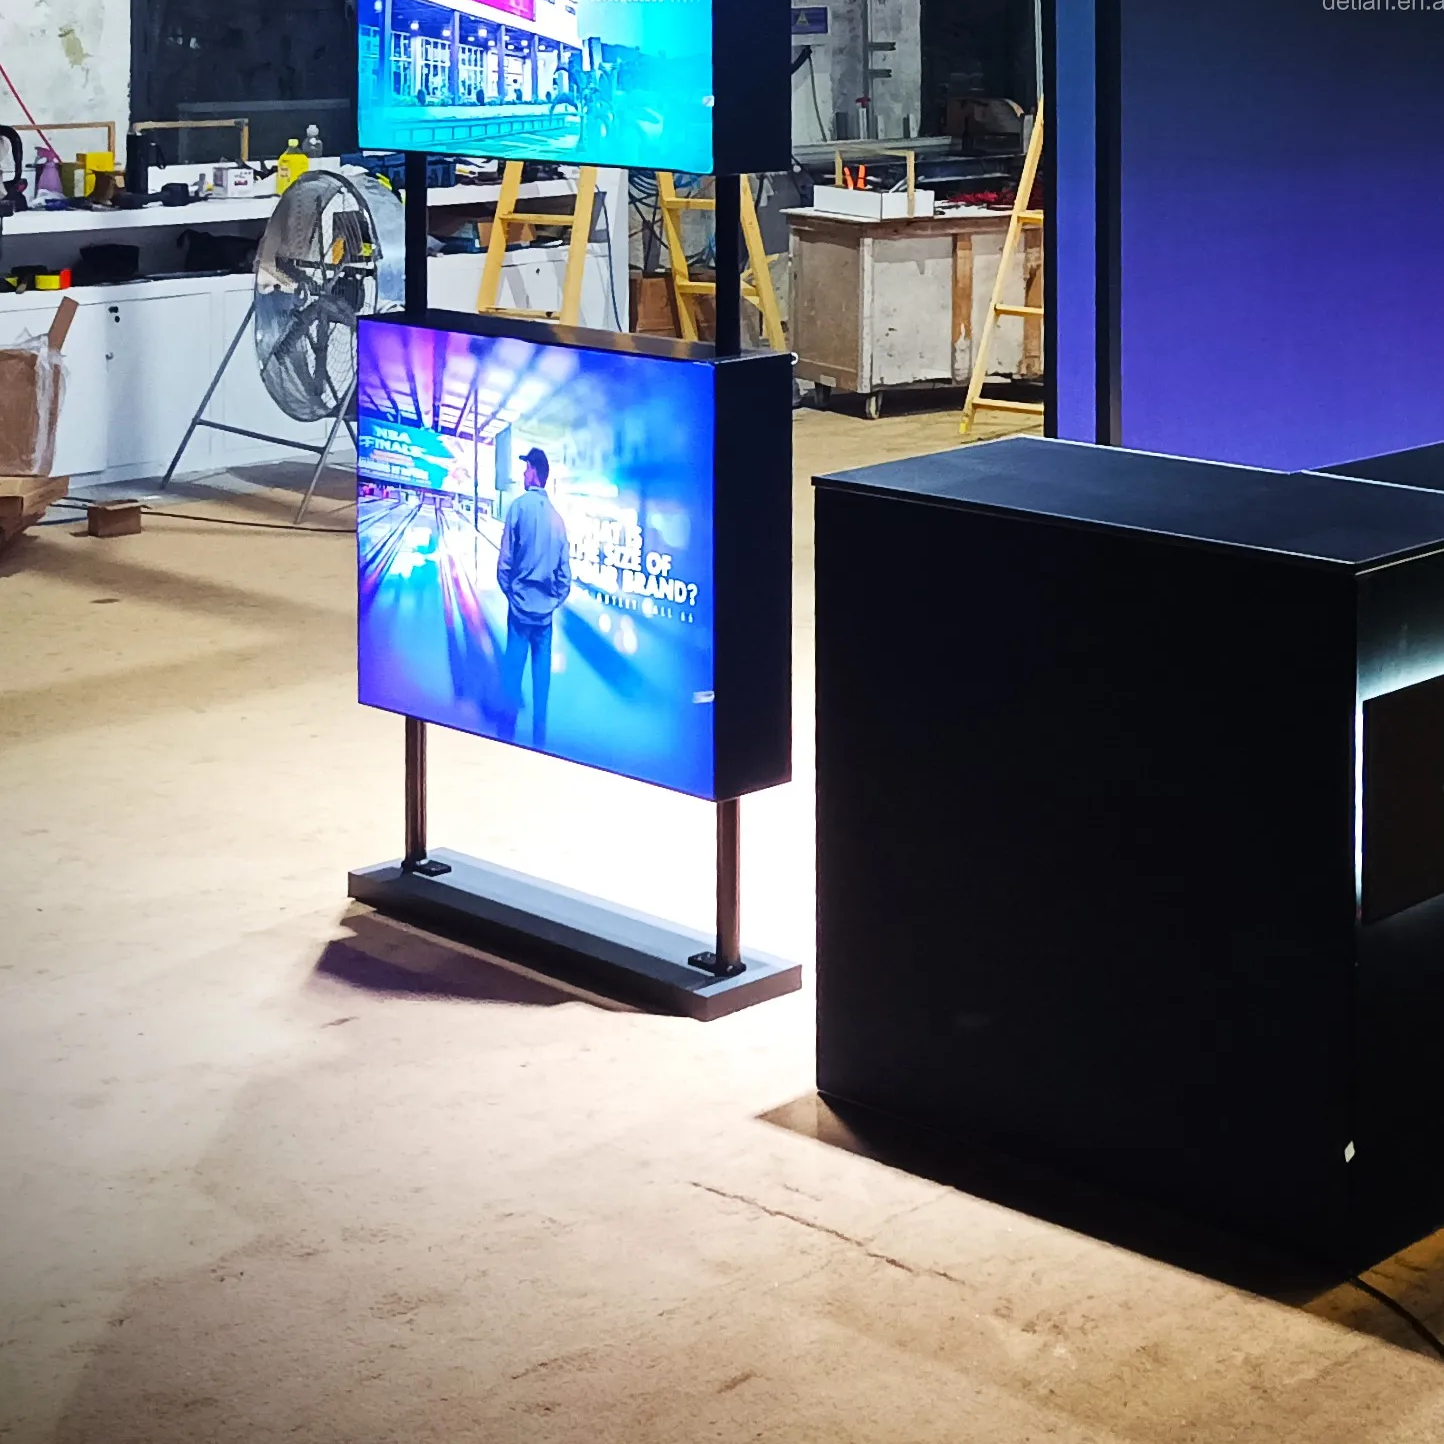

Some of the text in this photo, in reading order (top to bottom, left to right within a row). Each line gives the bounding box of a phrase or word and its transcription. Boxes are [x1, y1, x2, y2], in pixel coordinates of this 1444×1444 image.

[604, 544, 642, 572] SIZE
[646, 551, 673, 577] OF
[623, 569, 699, 607] BRAND?
